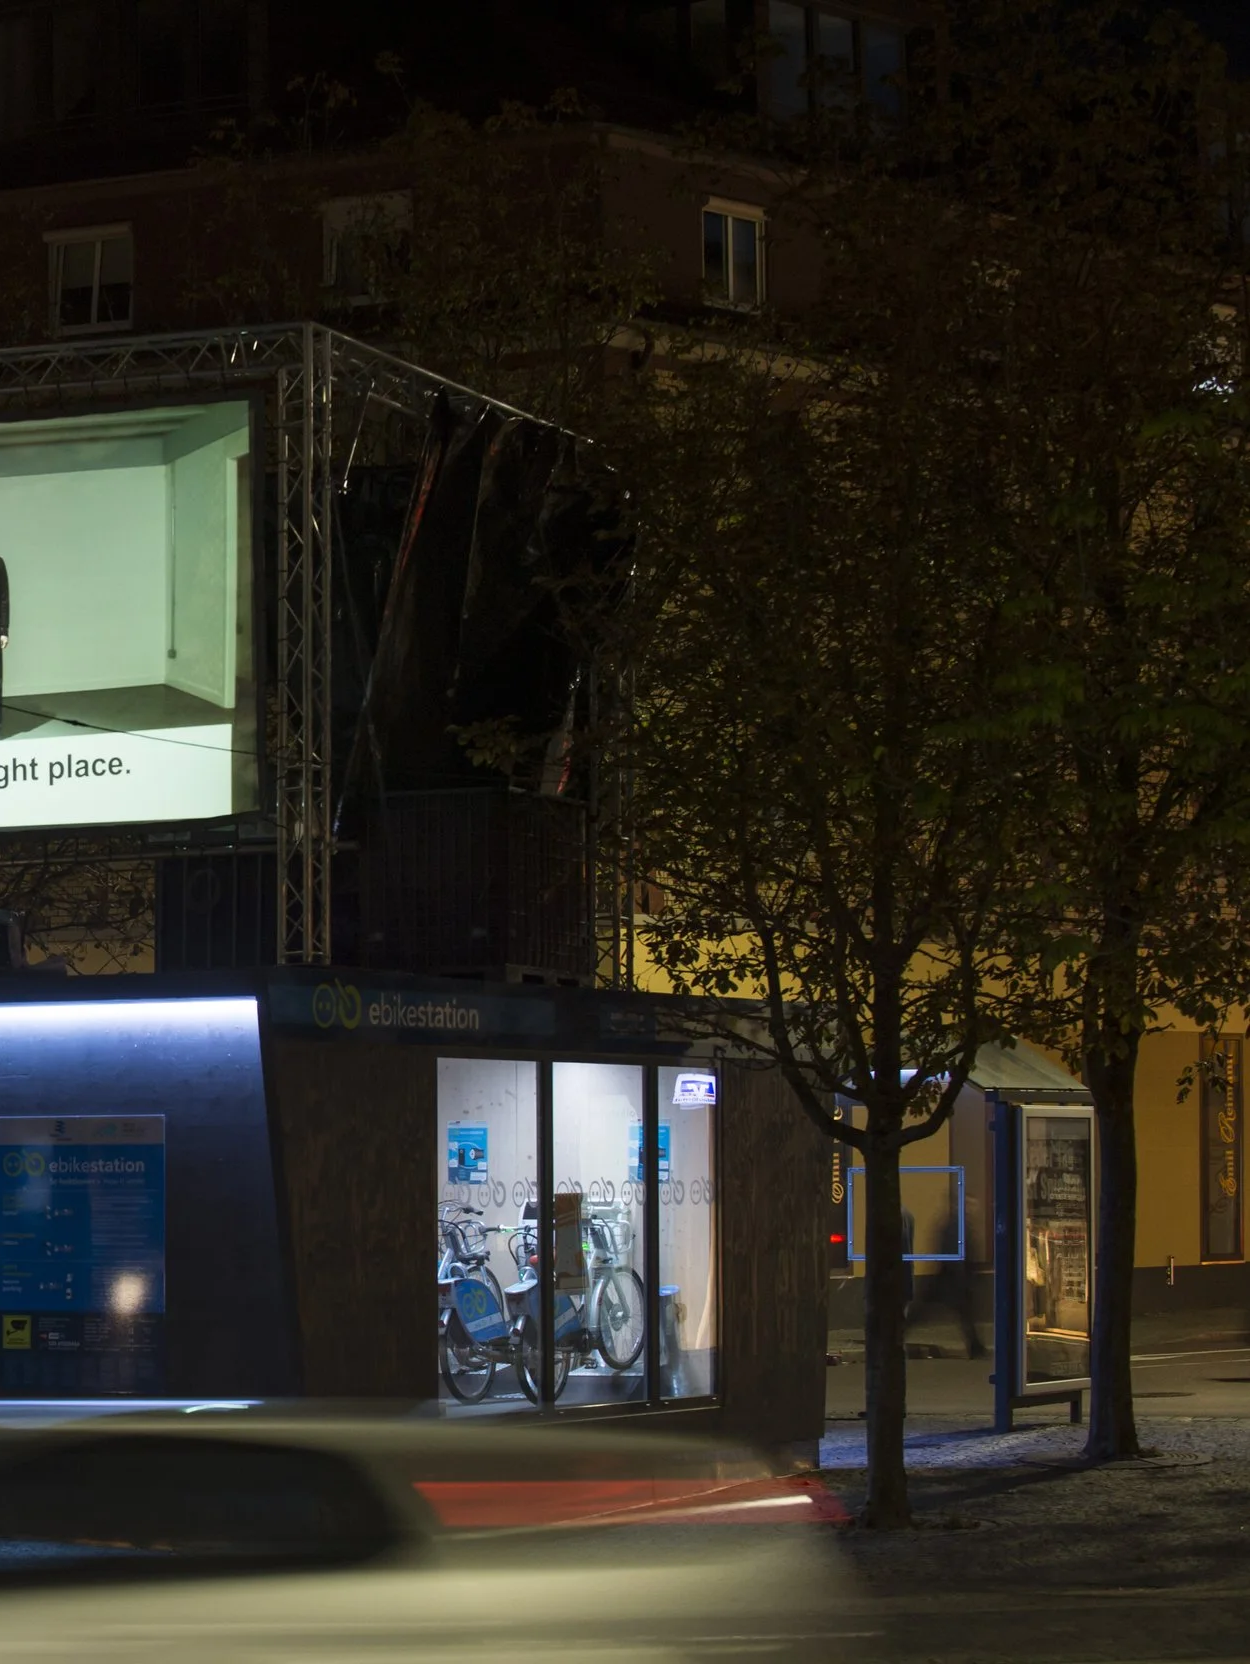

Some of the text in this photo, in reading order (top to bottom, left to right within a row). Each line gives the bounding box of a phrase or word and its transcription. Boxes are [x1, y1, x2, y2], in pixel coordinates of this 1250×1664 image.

[48, 753, 131, 786] place.
[368, 992, 480, 1031] ebikestation
[48, 1156, 146, 1173] ebikestation
[1219, 1148, 1238, 1197] Emil
